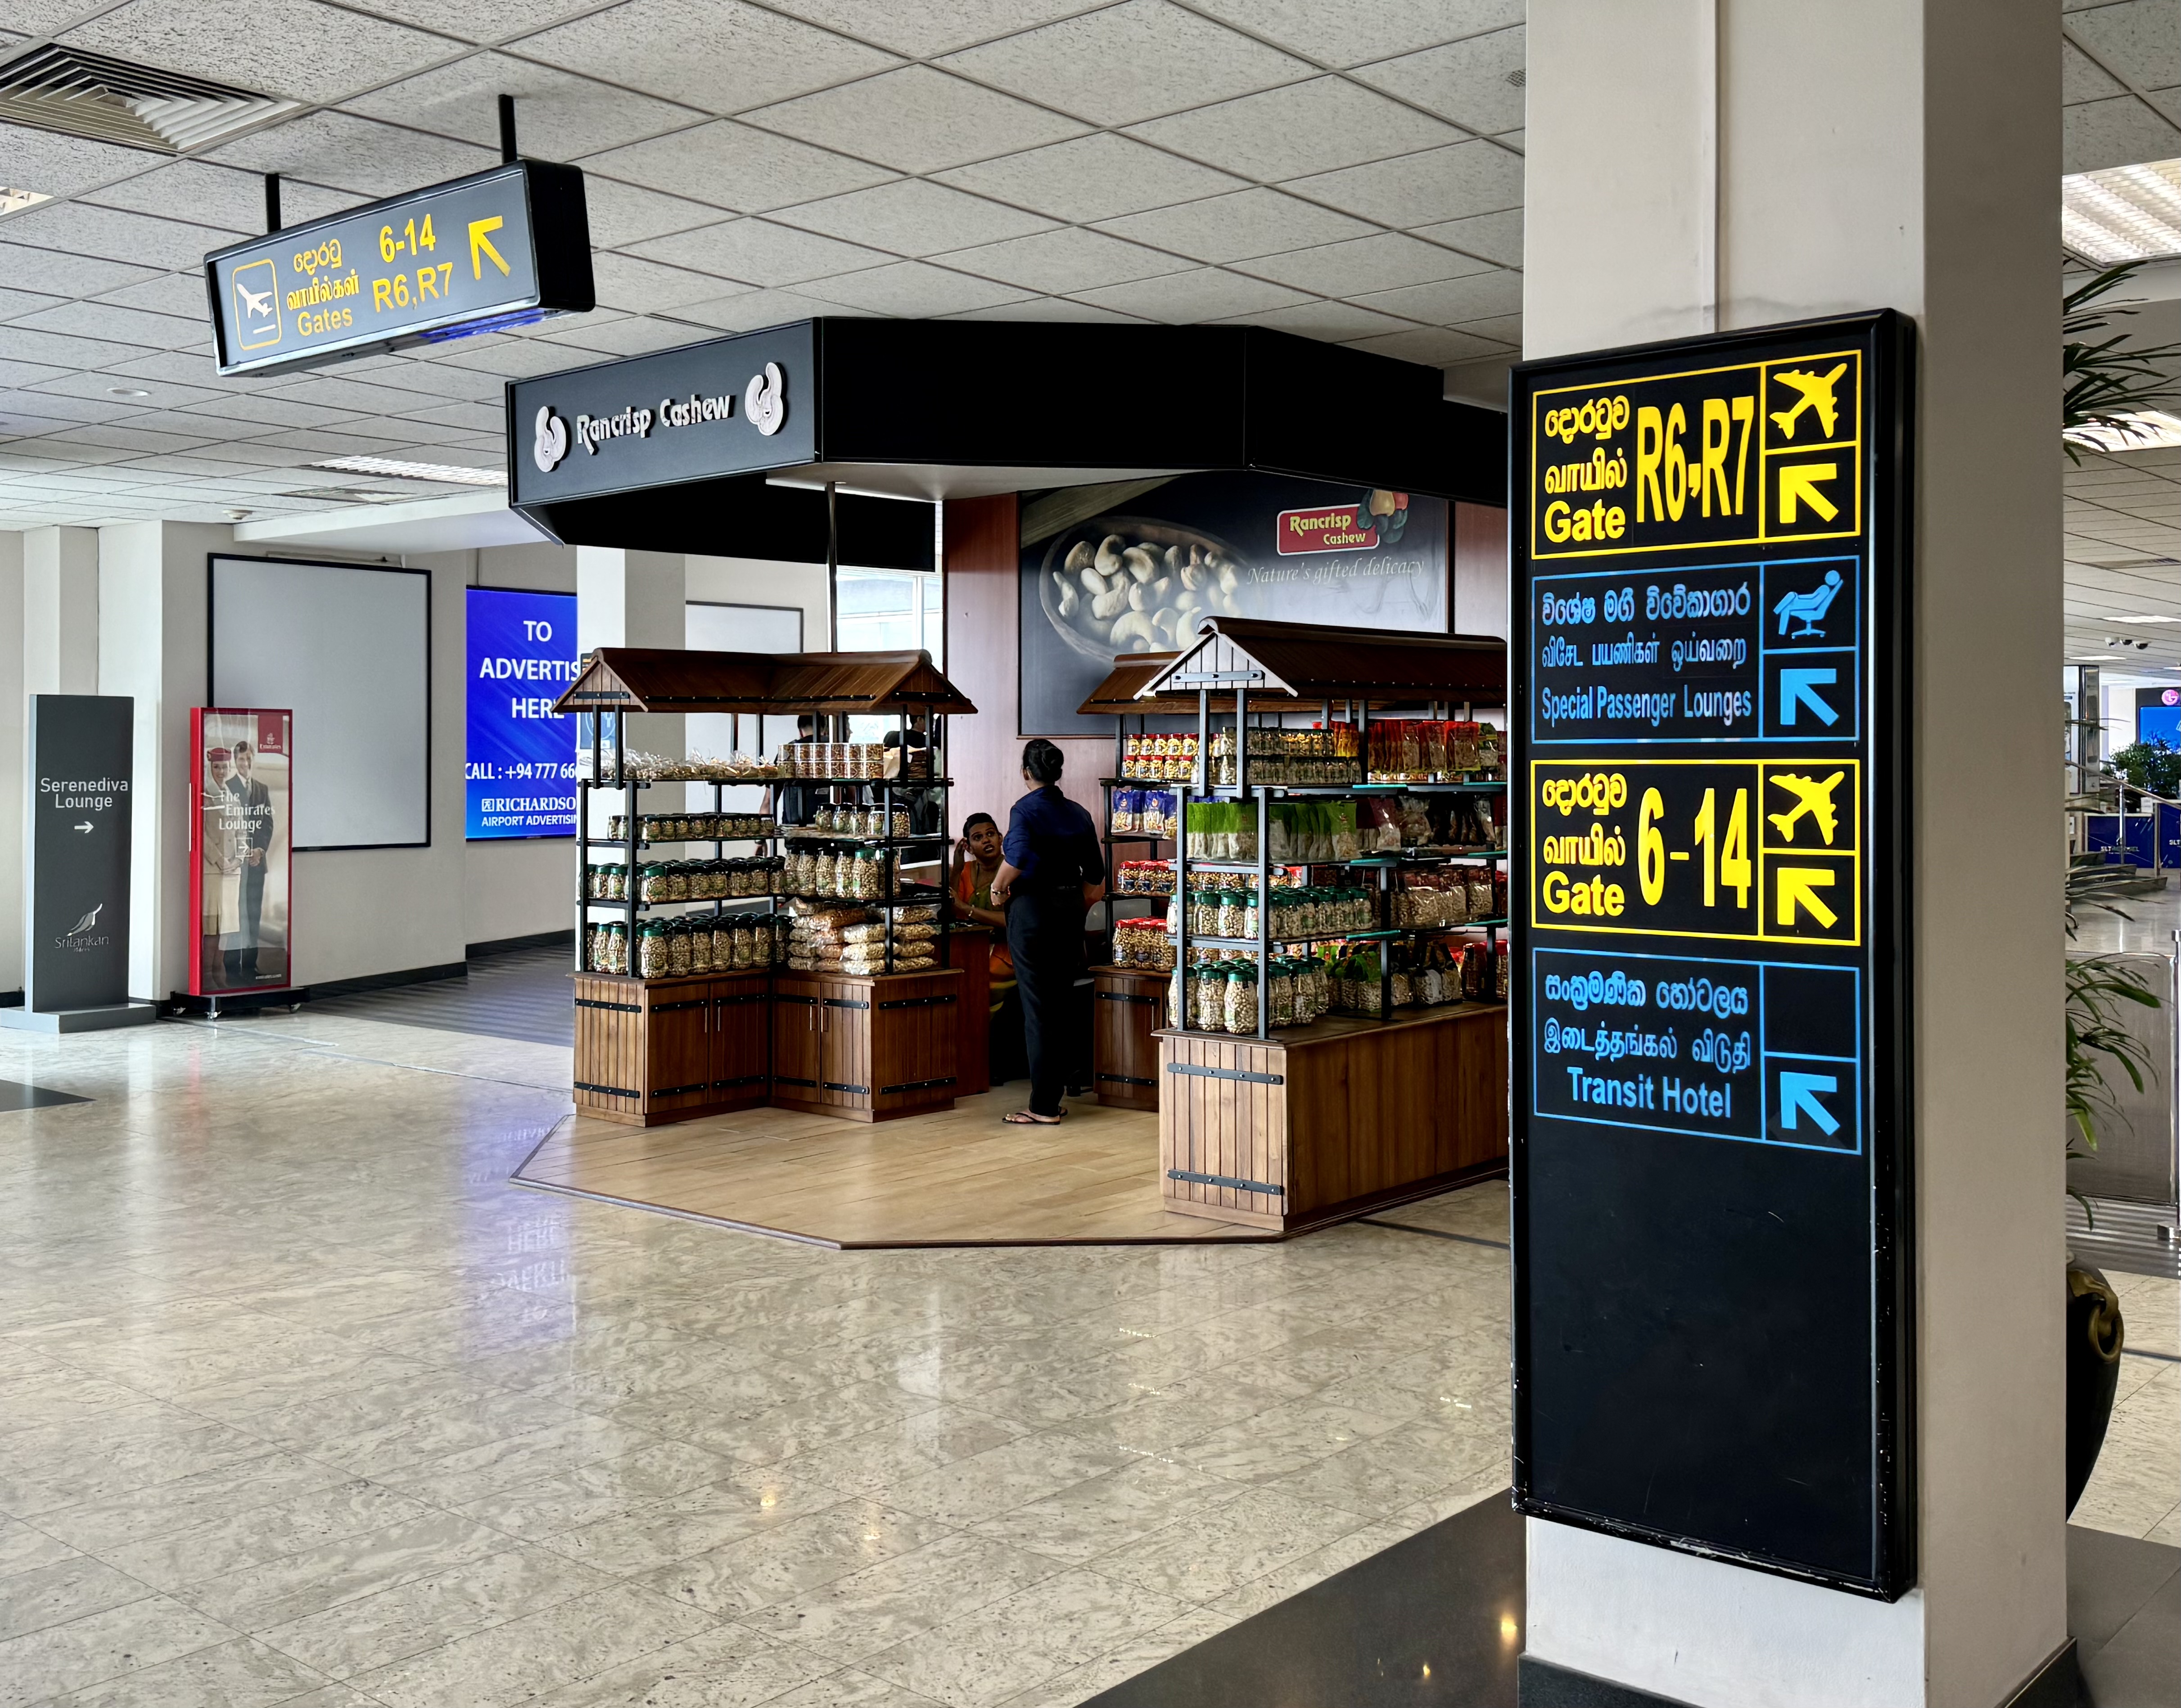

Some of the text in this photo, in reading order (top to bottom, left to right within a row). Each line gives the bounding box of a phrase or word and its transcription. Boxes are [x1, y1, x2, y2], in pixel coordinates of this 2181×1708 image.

[294, 239, 342, 276] දොරටු
[379, 214, 436, 263] 6-14
[287, 268, 359, 311] வாயில்கள்
[373, 262, 453, 312] R6,R7
[297, 307, 352, 336] Gates
[576, 394, 732, 456] Rancrisp Cashew
[1545, 395, 1630, 444] දොරටුව
[1545, 447, 1627, 494] வாயில்
[1637, 396, 1754, 522] R6,R7
[1289, 513, 1351, 537] Rancrisp
[1323, 532, 1366, 545] Cashew
[1544, 499, 1626, 543] Gate
[1246, 556, 1424, 585] Nature's gifted delicacy
[523, 620, 552, 642] TO
[1542, 635, 1584, 668] விசேட
[1592, 631, 1660, 665] பயணிகள்
[1542, 684, 1752, 727] Special Passenger Lounges
[41, 777, 128, 792] Serenediva
[465, 763, 495, 779] CALL
[505, 763, 532, 779] +94
[535, 763, 558, 779] 777
[560, 763, 577, 779] 66
[55, 794, 113, 811] Lounge
[219, 790, 240, 802] The
[226, 804, 275, 816] Emirates
[496, 797, 577, 812] RICHARDSO
[1543, 773, 1627, 816] දොරටුව
[219, 818, 262, 833] Lounge
[482, 816, 524, 827] AIRPORT
[1543, 822, 1626, 866] வாயில்
[1638, 787, 1752, 909] 6-14
[1543, 871, 1625, 917] Gate
[1544, 1017, 1751, 1074] இடைத்தங்கல் விடுதி
[1567, 1066, 1731, 1118] Transit Hotel
